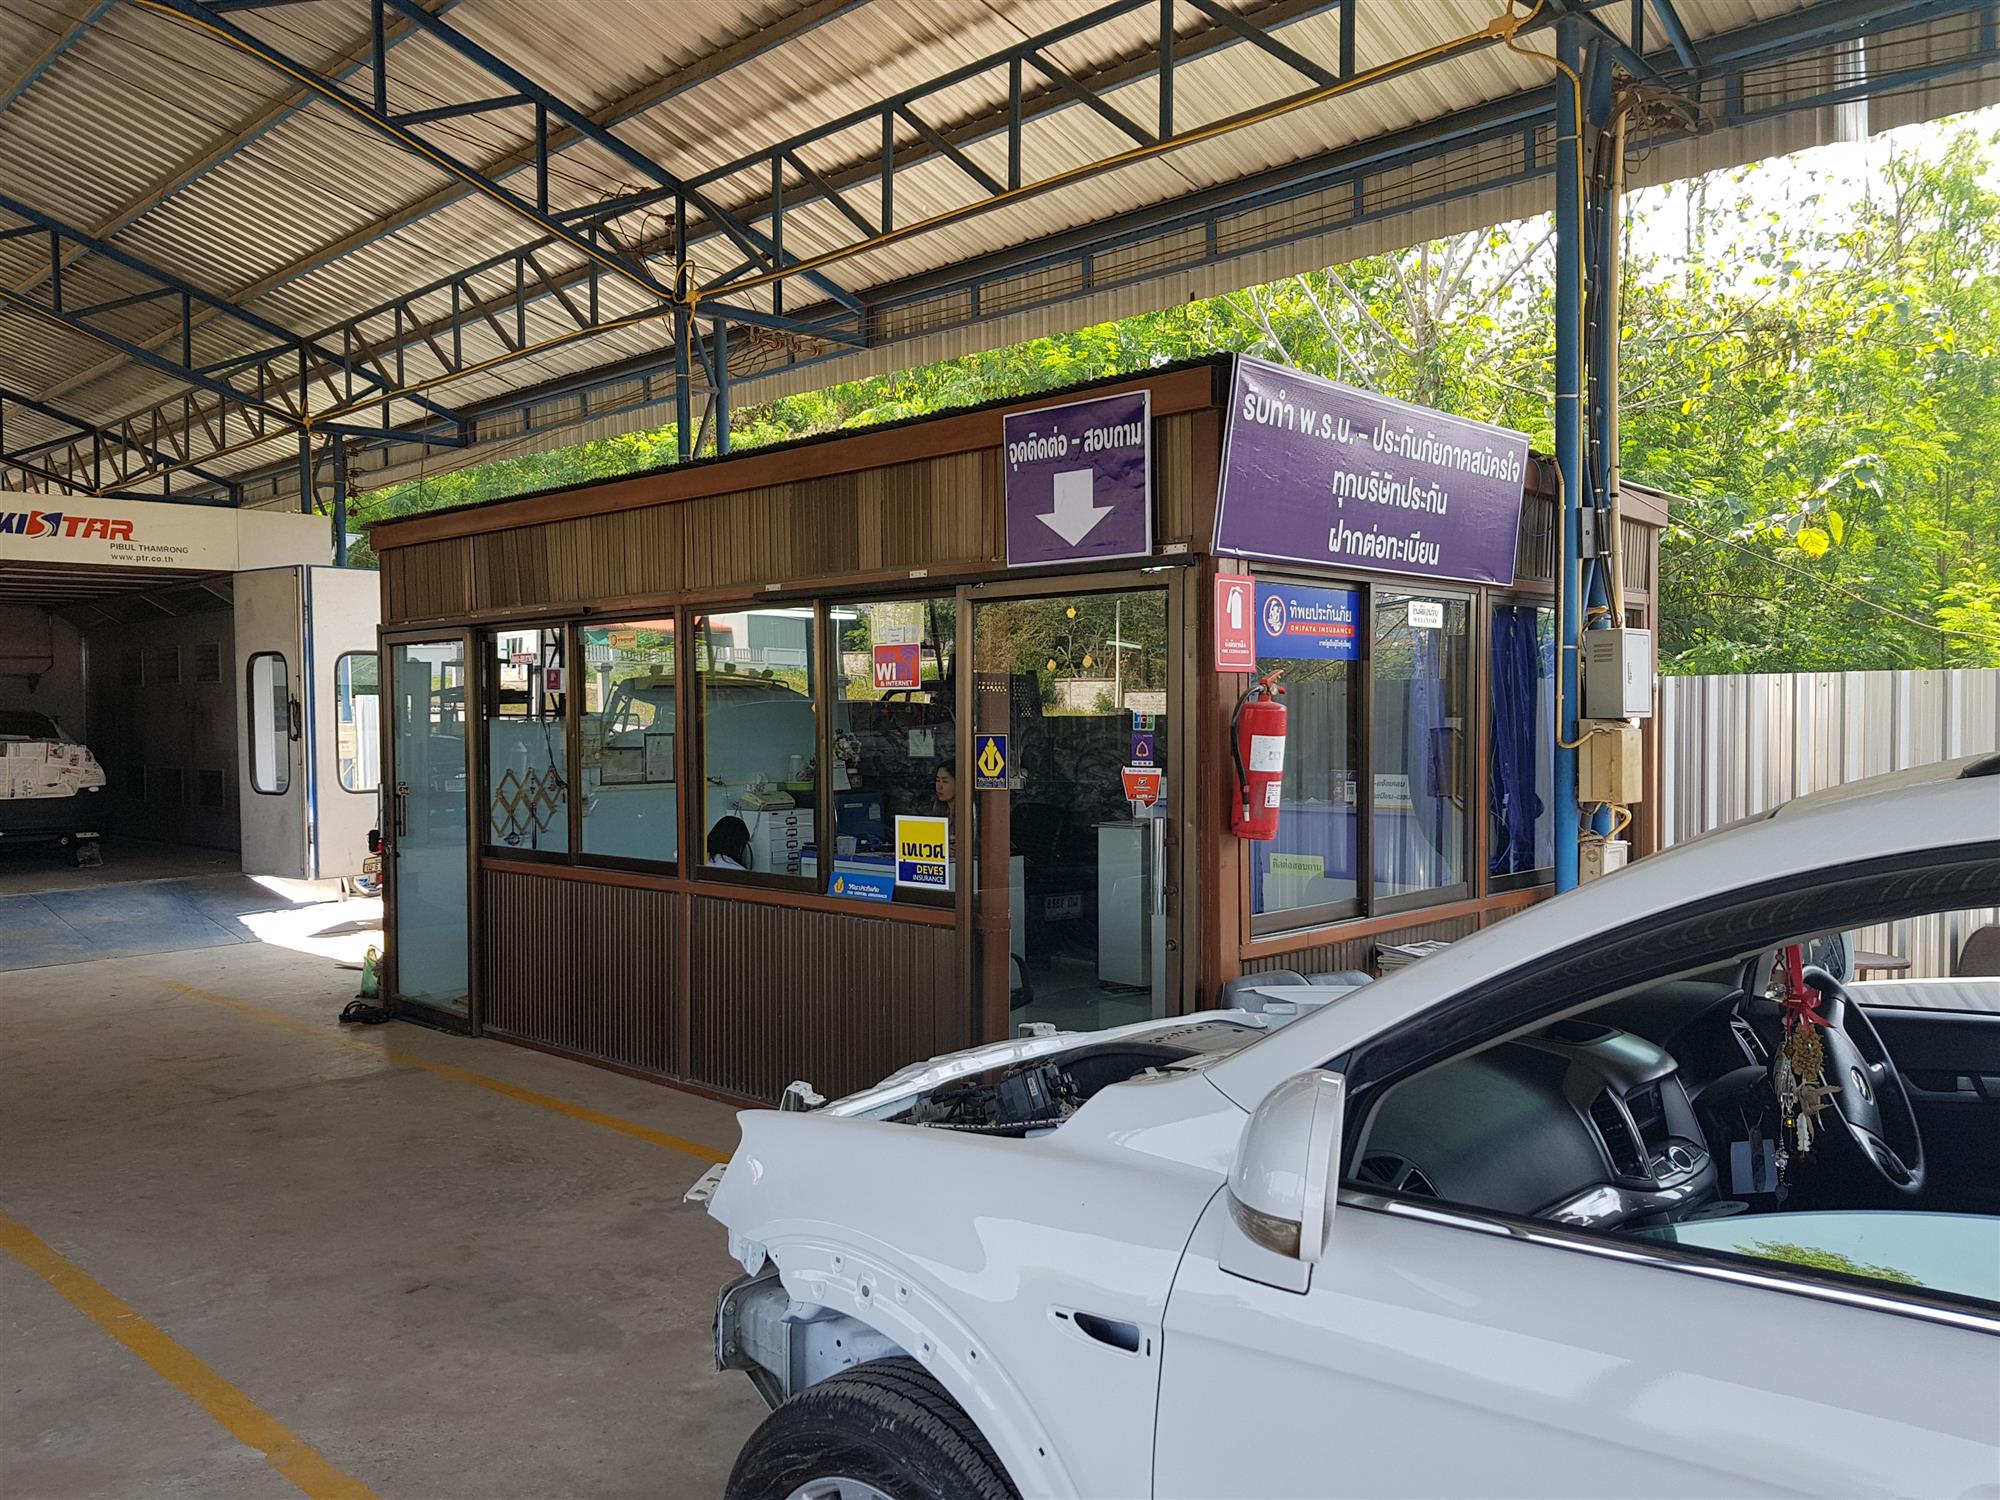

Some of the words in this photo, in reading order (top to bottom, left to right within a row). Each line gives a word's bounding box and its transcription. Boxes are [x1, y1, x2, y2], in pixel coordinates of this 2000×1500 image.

[1242, 383, 1295, 430] รับทำ
[1300, 407, 1354, 445] พ.ร.บ.
[1372, 418, 1521, 483] ประกันภัยภาคสมัครใจ
[1008, 425, 1068, 472] จุดติดต่อ
[1083, 421, 1142, 453] สอบถาม
[1332, 469, 1449, 515] ทุกบริษัทประกัน
[109, 542, 137, 552] PIBUL
[138, 543, 189, 554] THAMRONG
[1328, 519, 1440, 566] ฝากต่อทะเบียน
[110, 553, 174, 563] www.ptr.co.th
[1289, 599, 1352, 623] ทิพยประกันภัย
[1318, 625, 1352, 635] INSURANCE
[1135, 716, 1153, 724] JCB
[902, 841, 946, 860] เทเวศ
[916, 864, 944, 875] DEVES
[912, 874, 944, 883] INSURANCE
